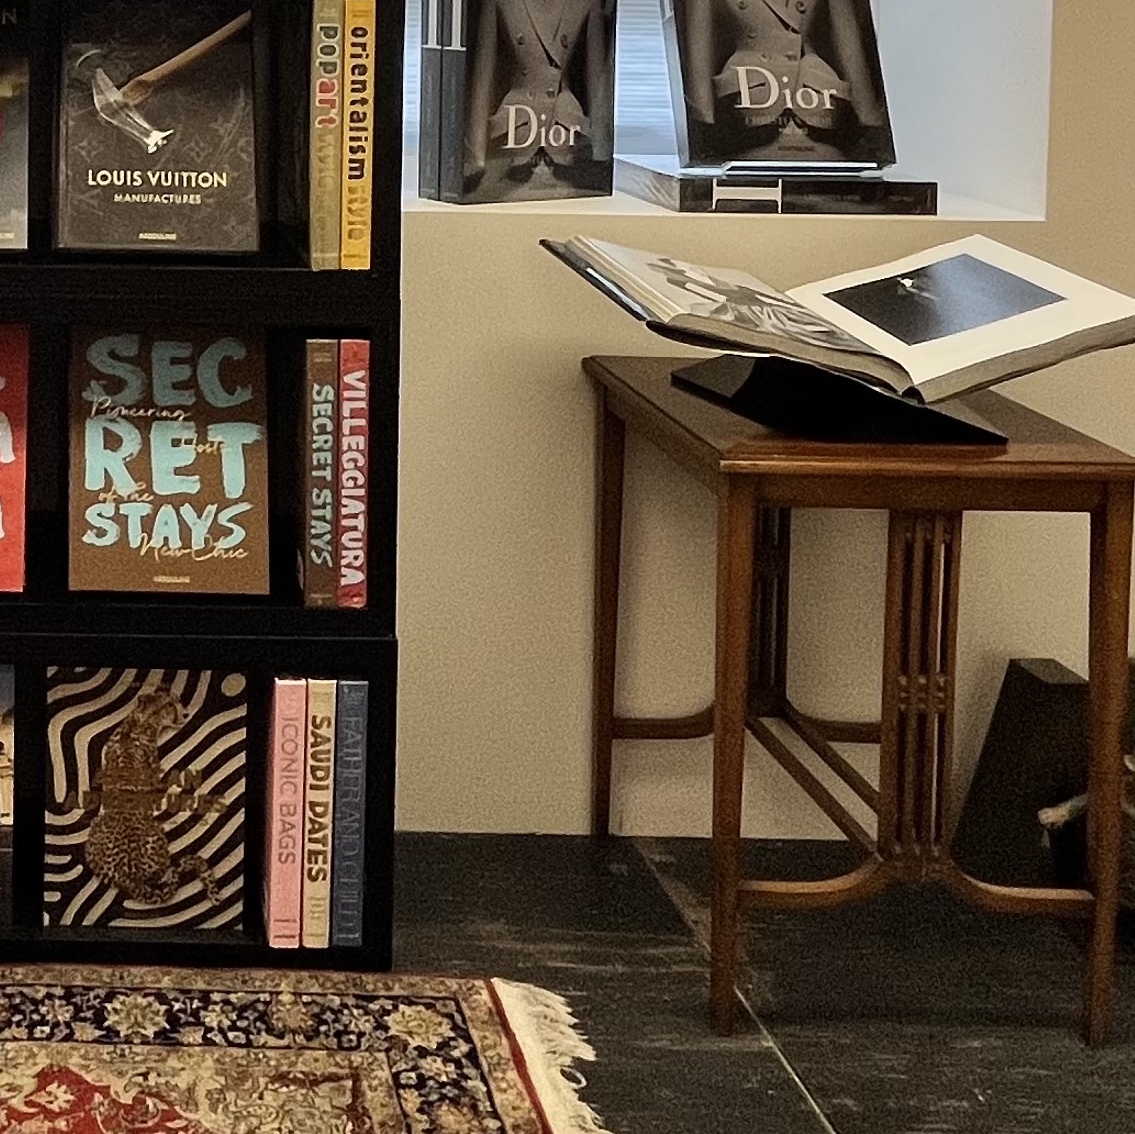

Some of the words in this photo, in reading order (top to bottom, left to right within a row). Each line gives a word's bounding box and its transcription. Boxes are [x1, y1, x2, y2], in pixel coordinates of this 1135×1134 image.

[348, 26, 369, 181] orientalism
[734, 66, 837, 109] Dior
[501, 104, 581, 149] Dior
[88, 168, 143, 187] LOUIS
[147, 170, 227, 188] VUITTON
[114, 192, 201, 205] MANUFACTURES
[82, 333, 253, 408] SEC
[83, 416, 263, 500] RET
[312, 383, 334, 482] SECRET
[340, 369, 366, 586] VILLEGGIATURA
[81, 502, 254, 550] STAYS
[310, 487, 333, 568] STAYS
[279, 716, 299, 796] ICONIC
[309, 714, 332, 791] SAUDI
[277, 802, 297, 866] BAGS
[307, 801, 330, 883] DATES
